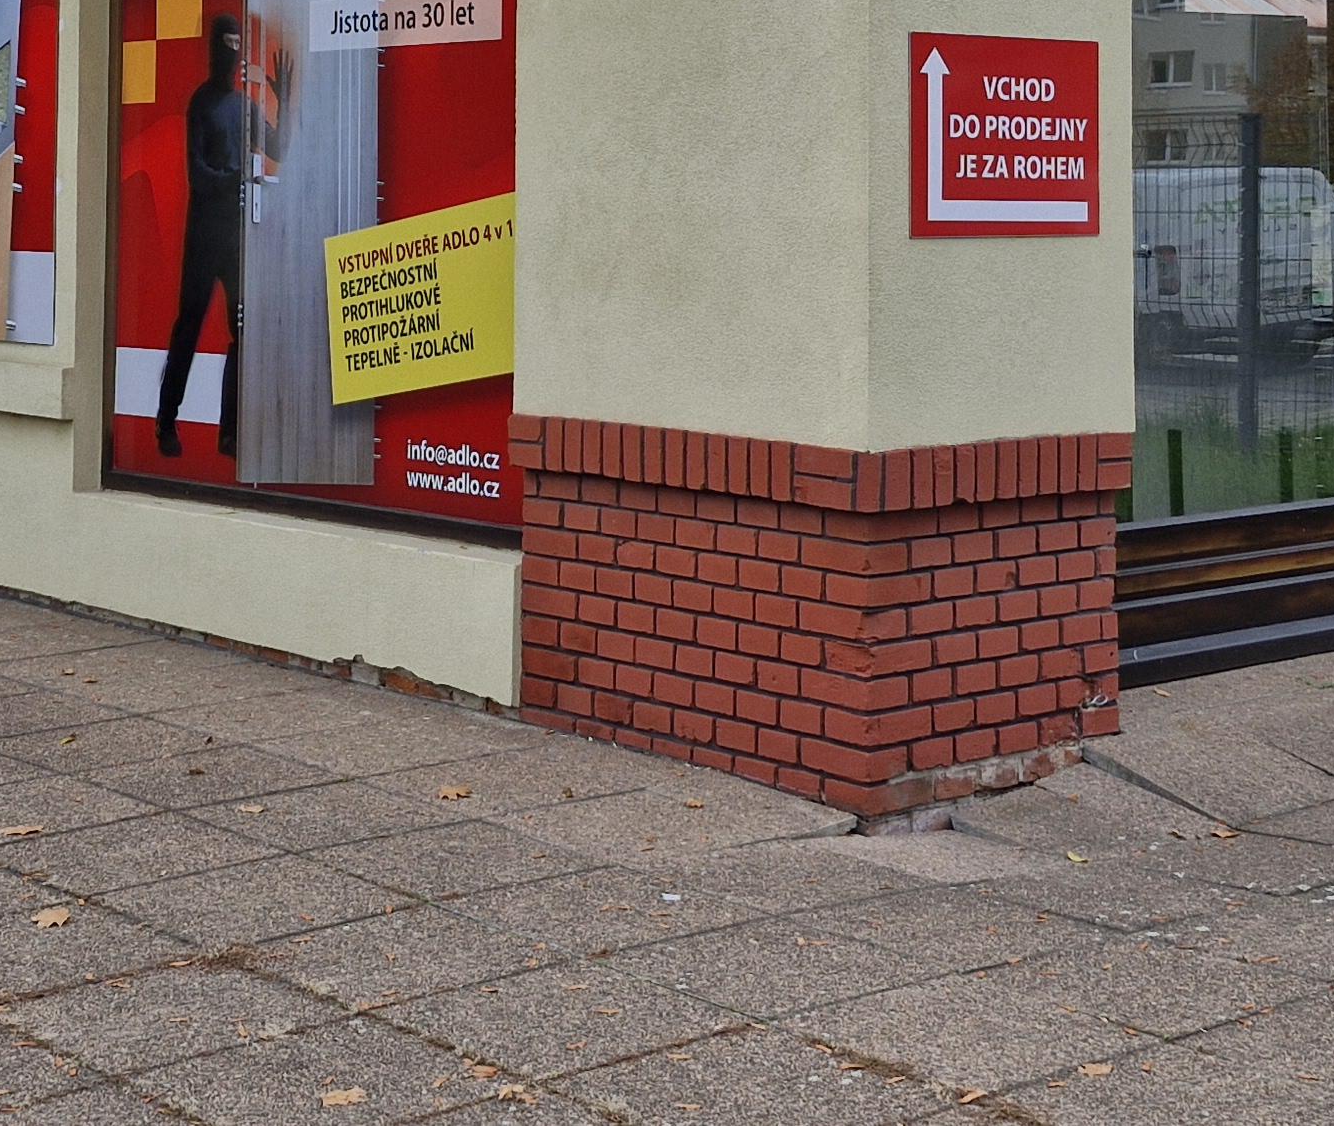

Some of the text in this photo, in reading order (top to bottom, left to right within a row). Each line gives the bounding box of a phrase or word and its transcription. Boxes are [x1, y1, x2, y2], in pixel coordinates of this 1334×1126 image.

[330, 0, 475, 35] Jistota na 30 let
[983, 76, 1055, 102] VCHOD
[949, 114, 1088, 141] DO PRODEJNY
[955, 154, 1085, 180] JE ZA ROHEM
[338, 219, 514, 274] VSTUPNÍ DVEŘE ADLO 4 v 1
[340, 258, 438, 300] BEZPEČNOSTNÍ
[342, 283, 442, 324] PROTIHLUKOVÉ
[343, 309, 441, 348] PROTIPOŽÁRNÍ
[345, 342, 401, 372] TEPELNĚ
[410, 327, 475, 362] IZOLAČNÍ
[406, 438, 500, 470] info@adlo.cz
[406, 470, 500, 498] www.adlo.cz
